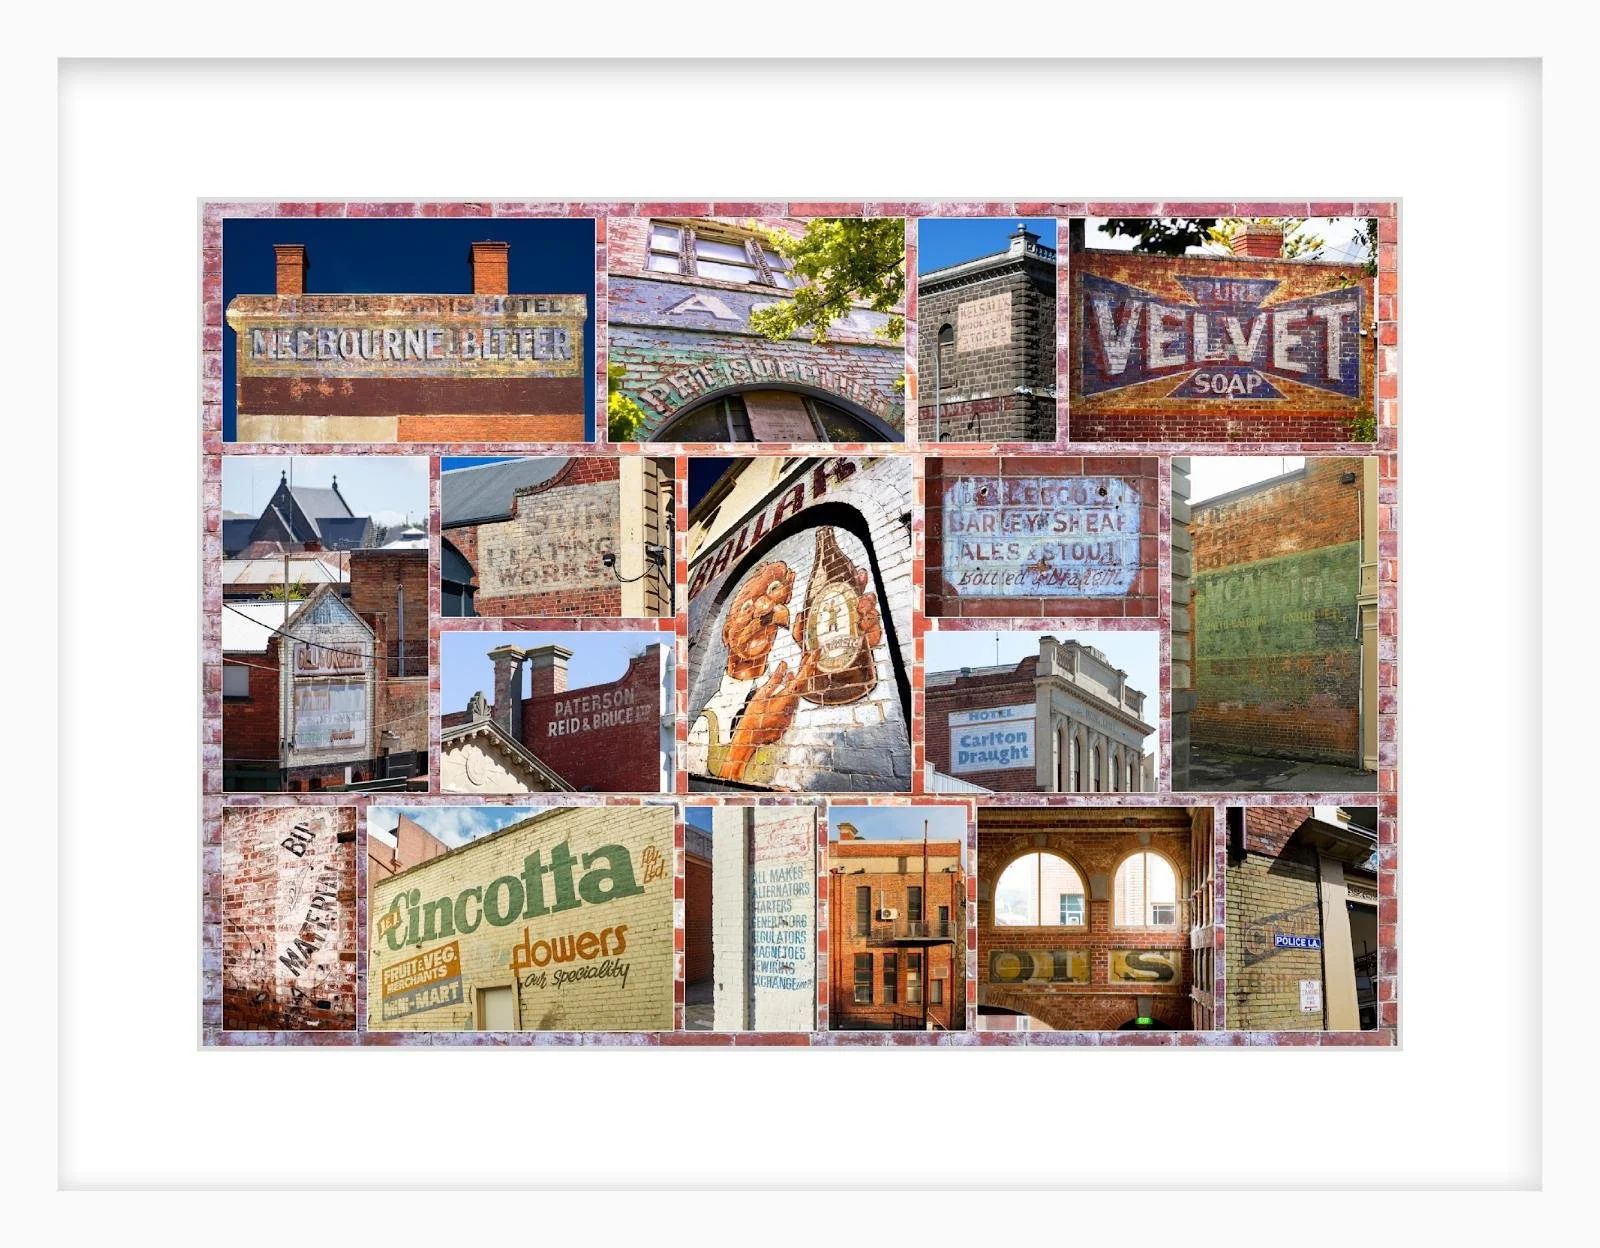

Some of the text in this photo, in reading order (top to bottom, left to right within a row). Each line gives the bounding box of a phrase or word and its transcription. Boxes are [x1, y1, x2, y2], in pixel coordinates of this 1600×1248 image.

[1091, 298, 1355, 380] VELVET
[638, 361, 718, 416] PET
[1191, 373, 1261, 395] SOAP
[949, 512, 1038, 533] BARLEY
[961, 542, 1020, 561] ALES
[1043, 541, 1114, 562] STOUT
[555, 688, 635, 717] PATERSON
[548, 717, 580, 737] REID
[582, 717, 591, 731] &
[593, 706, 634, 729] BRUCE
[968, 707, 1014, 721] HOTEL
[960, 729, 1028, 749] Carlton
[958, 744, 1029, 765] Draught
[769, 866, 804, 883] MAKES
[387, 840, 645, 951] Cincotta
[752, 881, 810, 899] ALTERNATORS
[1276, 936, 1320, 948] POLICE LA.
[384, 957, 418, 984] FRUIT
[386, 965, 448, 994] MERCHANTS
